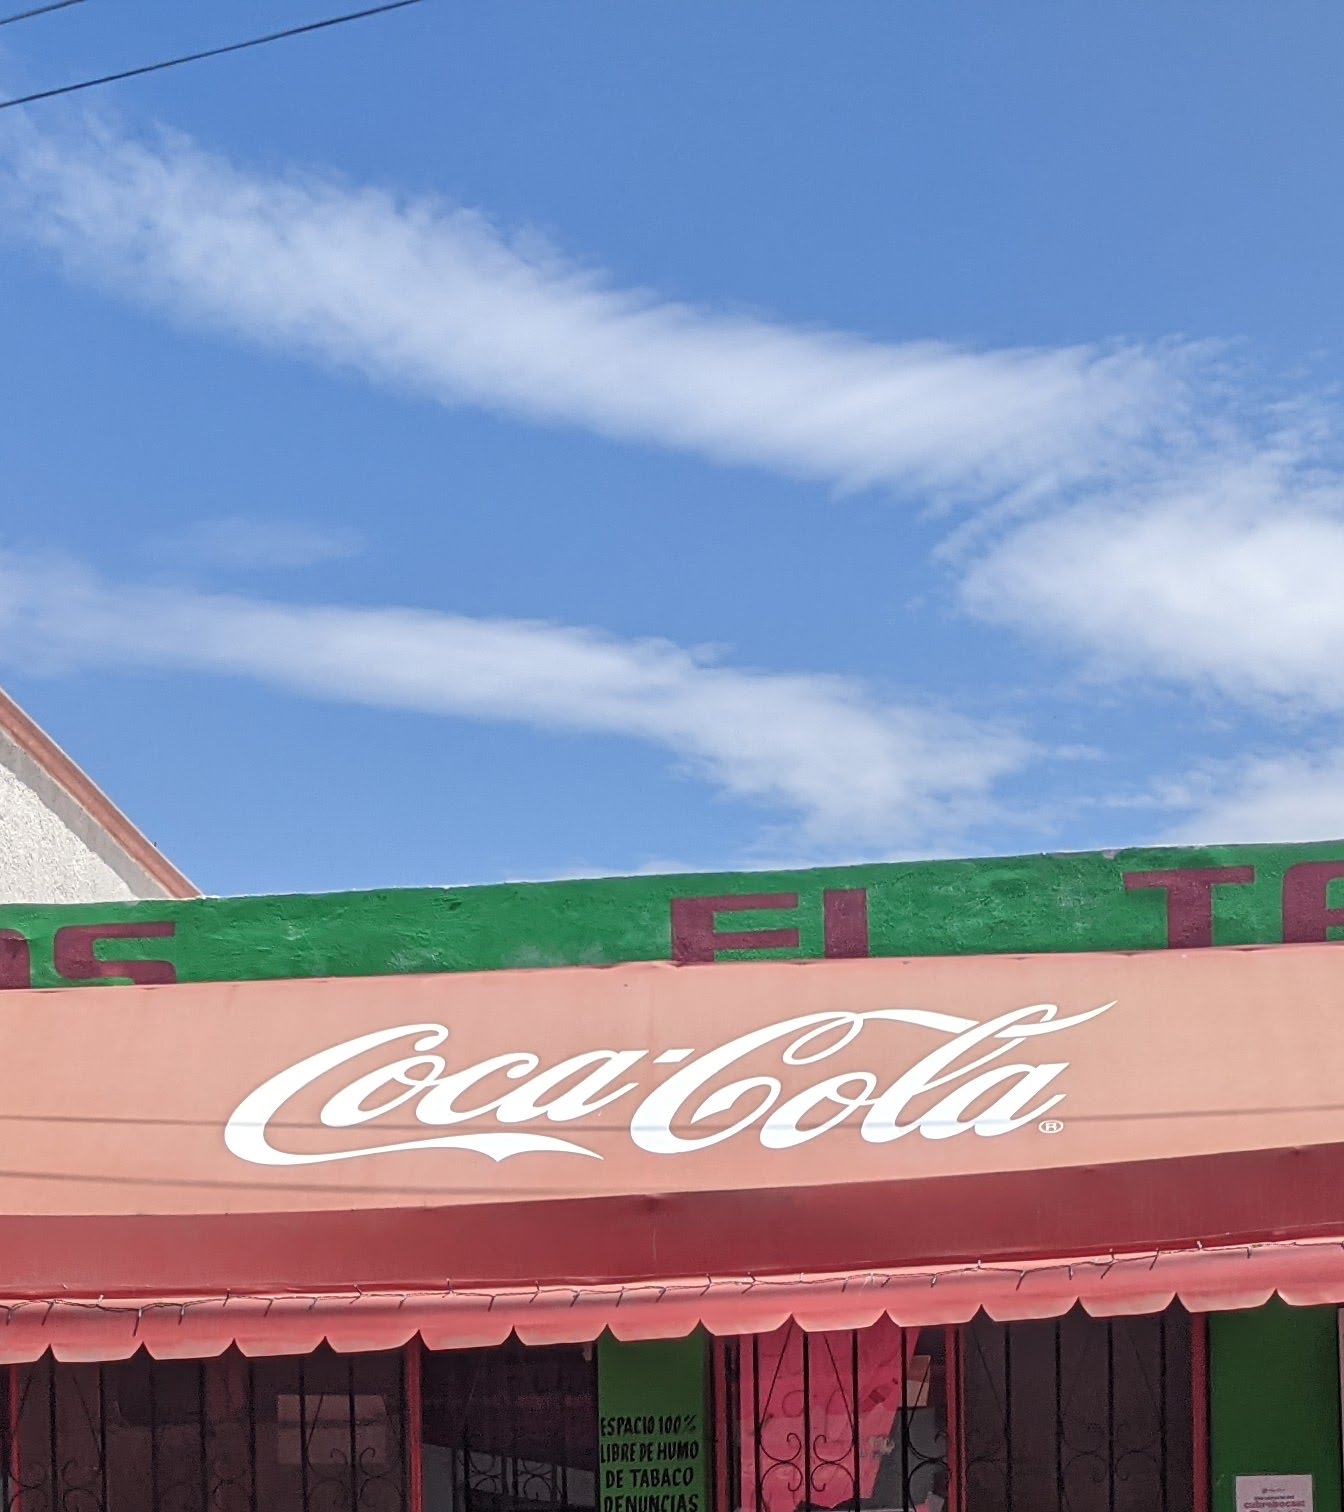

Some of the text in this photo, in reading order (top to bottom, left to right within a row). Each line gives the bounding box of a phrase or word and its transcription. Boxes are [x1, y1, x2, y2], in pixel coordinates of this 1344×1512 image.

[223, 1000, 1119, 1166] Coca-Cola
[600, 1415, 655, 1436] ESPACIO
[600, 1440, 699, 1463] LIBRE DE HUMO
[605, 1466, 694, 1488] DE TABACO
